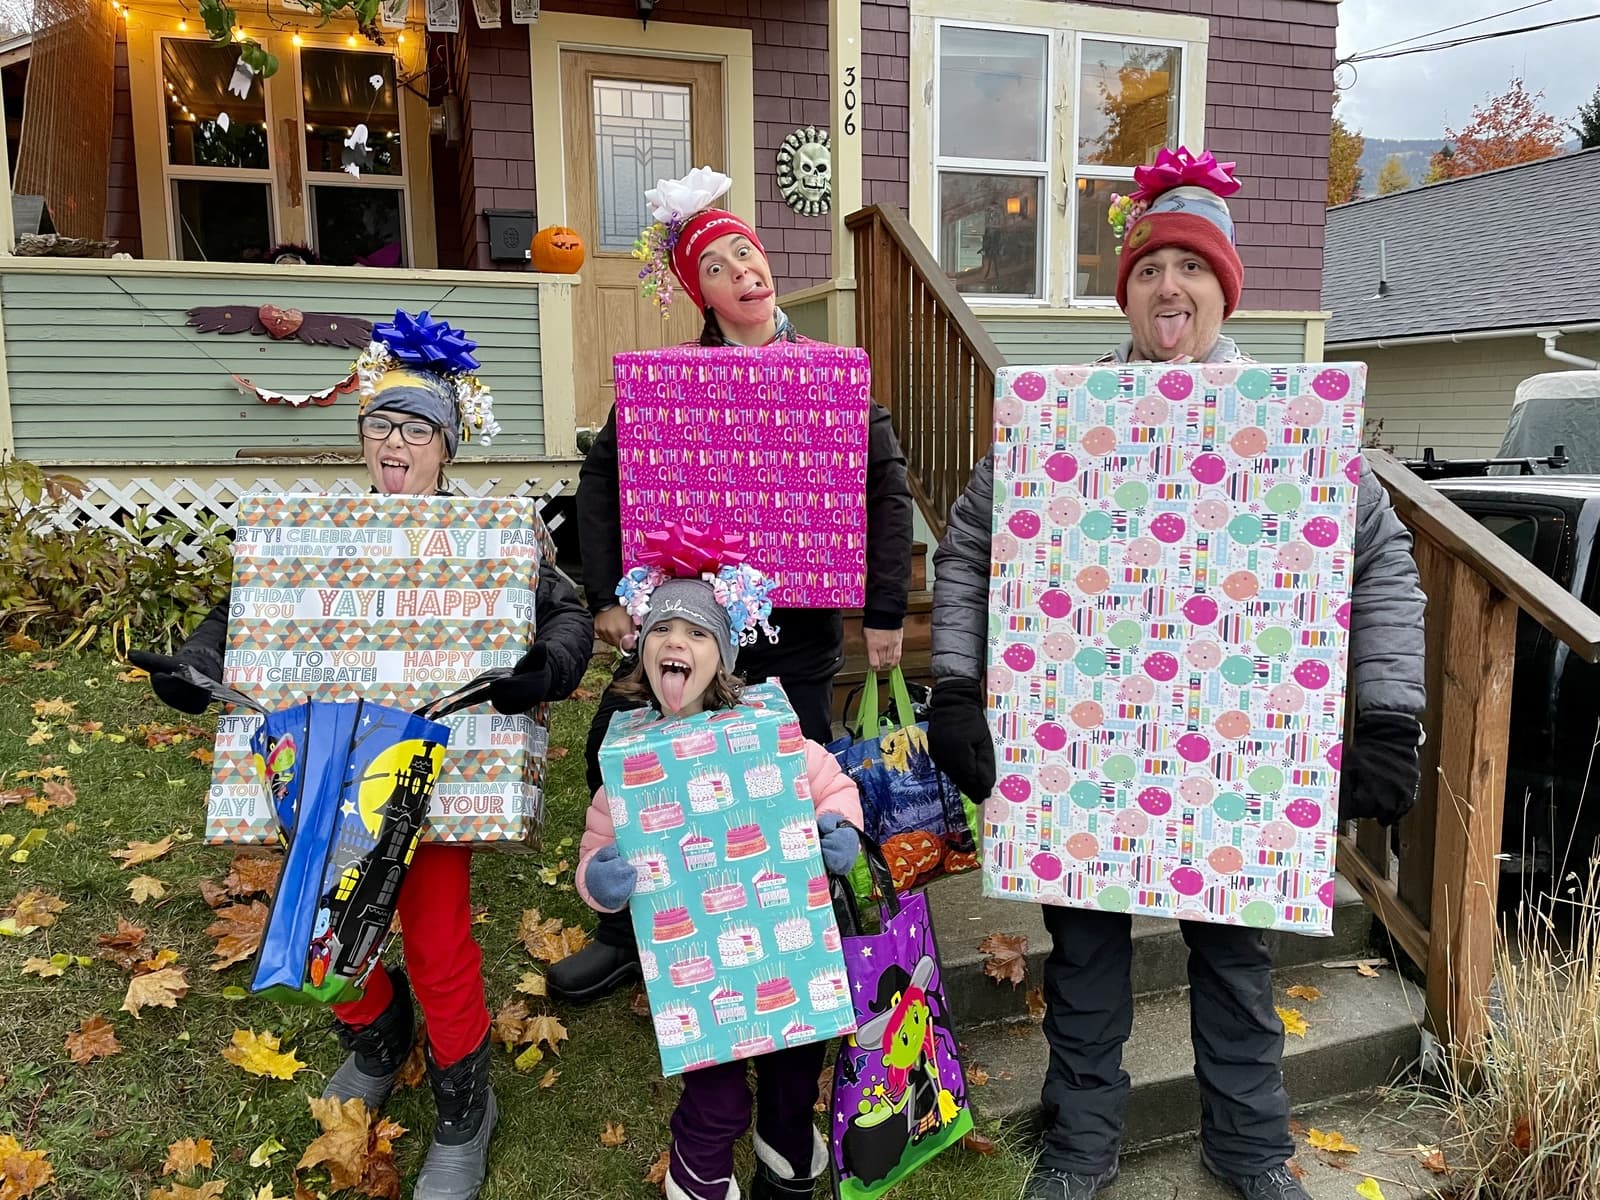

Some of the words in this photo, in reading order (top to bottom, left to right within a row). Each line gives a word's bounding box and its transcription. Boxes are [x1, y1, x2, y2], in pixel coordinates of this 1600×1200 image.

[843, 66, 856, 136] 306
[1104, 456, 1143, 472] HAPPY
[1255, 458, 1294, 474] HAPPY
[262, 545, 334, 557] BIRTHDAY
[337, 545, 357, 557] TO
[361, 546, 393, 557] YOU
[286, 529, 394, 544] CELEBRATE!
[404, 529, 487, 557] YAY!
[252, 604, 301, 618] YOU
[318, 589, 386, 617] YAY!
[396, 589, 501, 617] HAPPY
[1097, 595, 1136, 611] HAPPY
[1246, 601, 1286, 617] HAPPY
[292, 651, 324, 668] TO
[330, 651, 377, 668] YOU
[404, 651, 475, 668] HAPPY
[267, 667, 378, 683] CELEBRATE!
[1092, 730, 1130, 746] HAPPY
[1238, 740, 1278, 756] HAPPY
[227, 785, 259, 798] YOU
[438, 783, 509, 795] BIRTHDAY
[439, 796, 505, 815] YOUR
[1087, 861, 1125, 877] HAPPY
[1231, 875, 1270, 892] HAPPY
